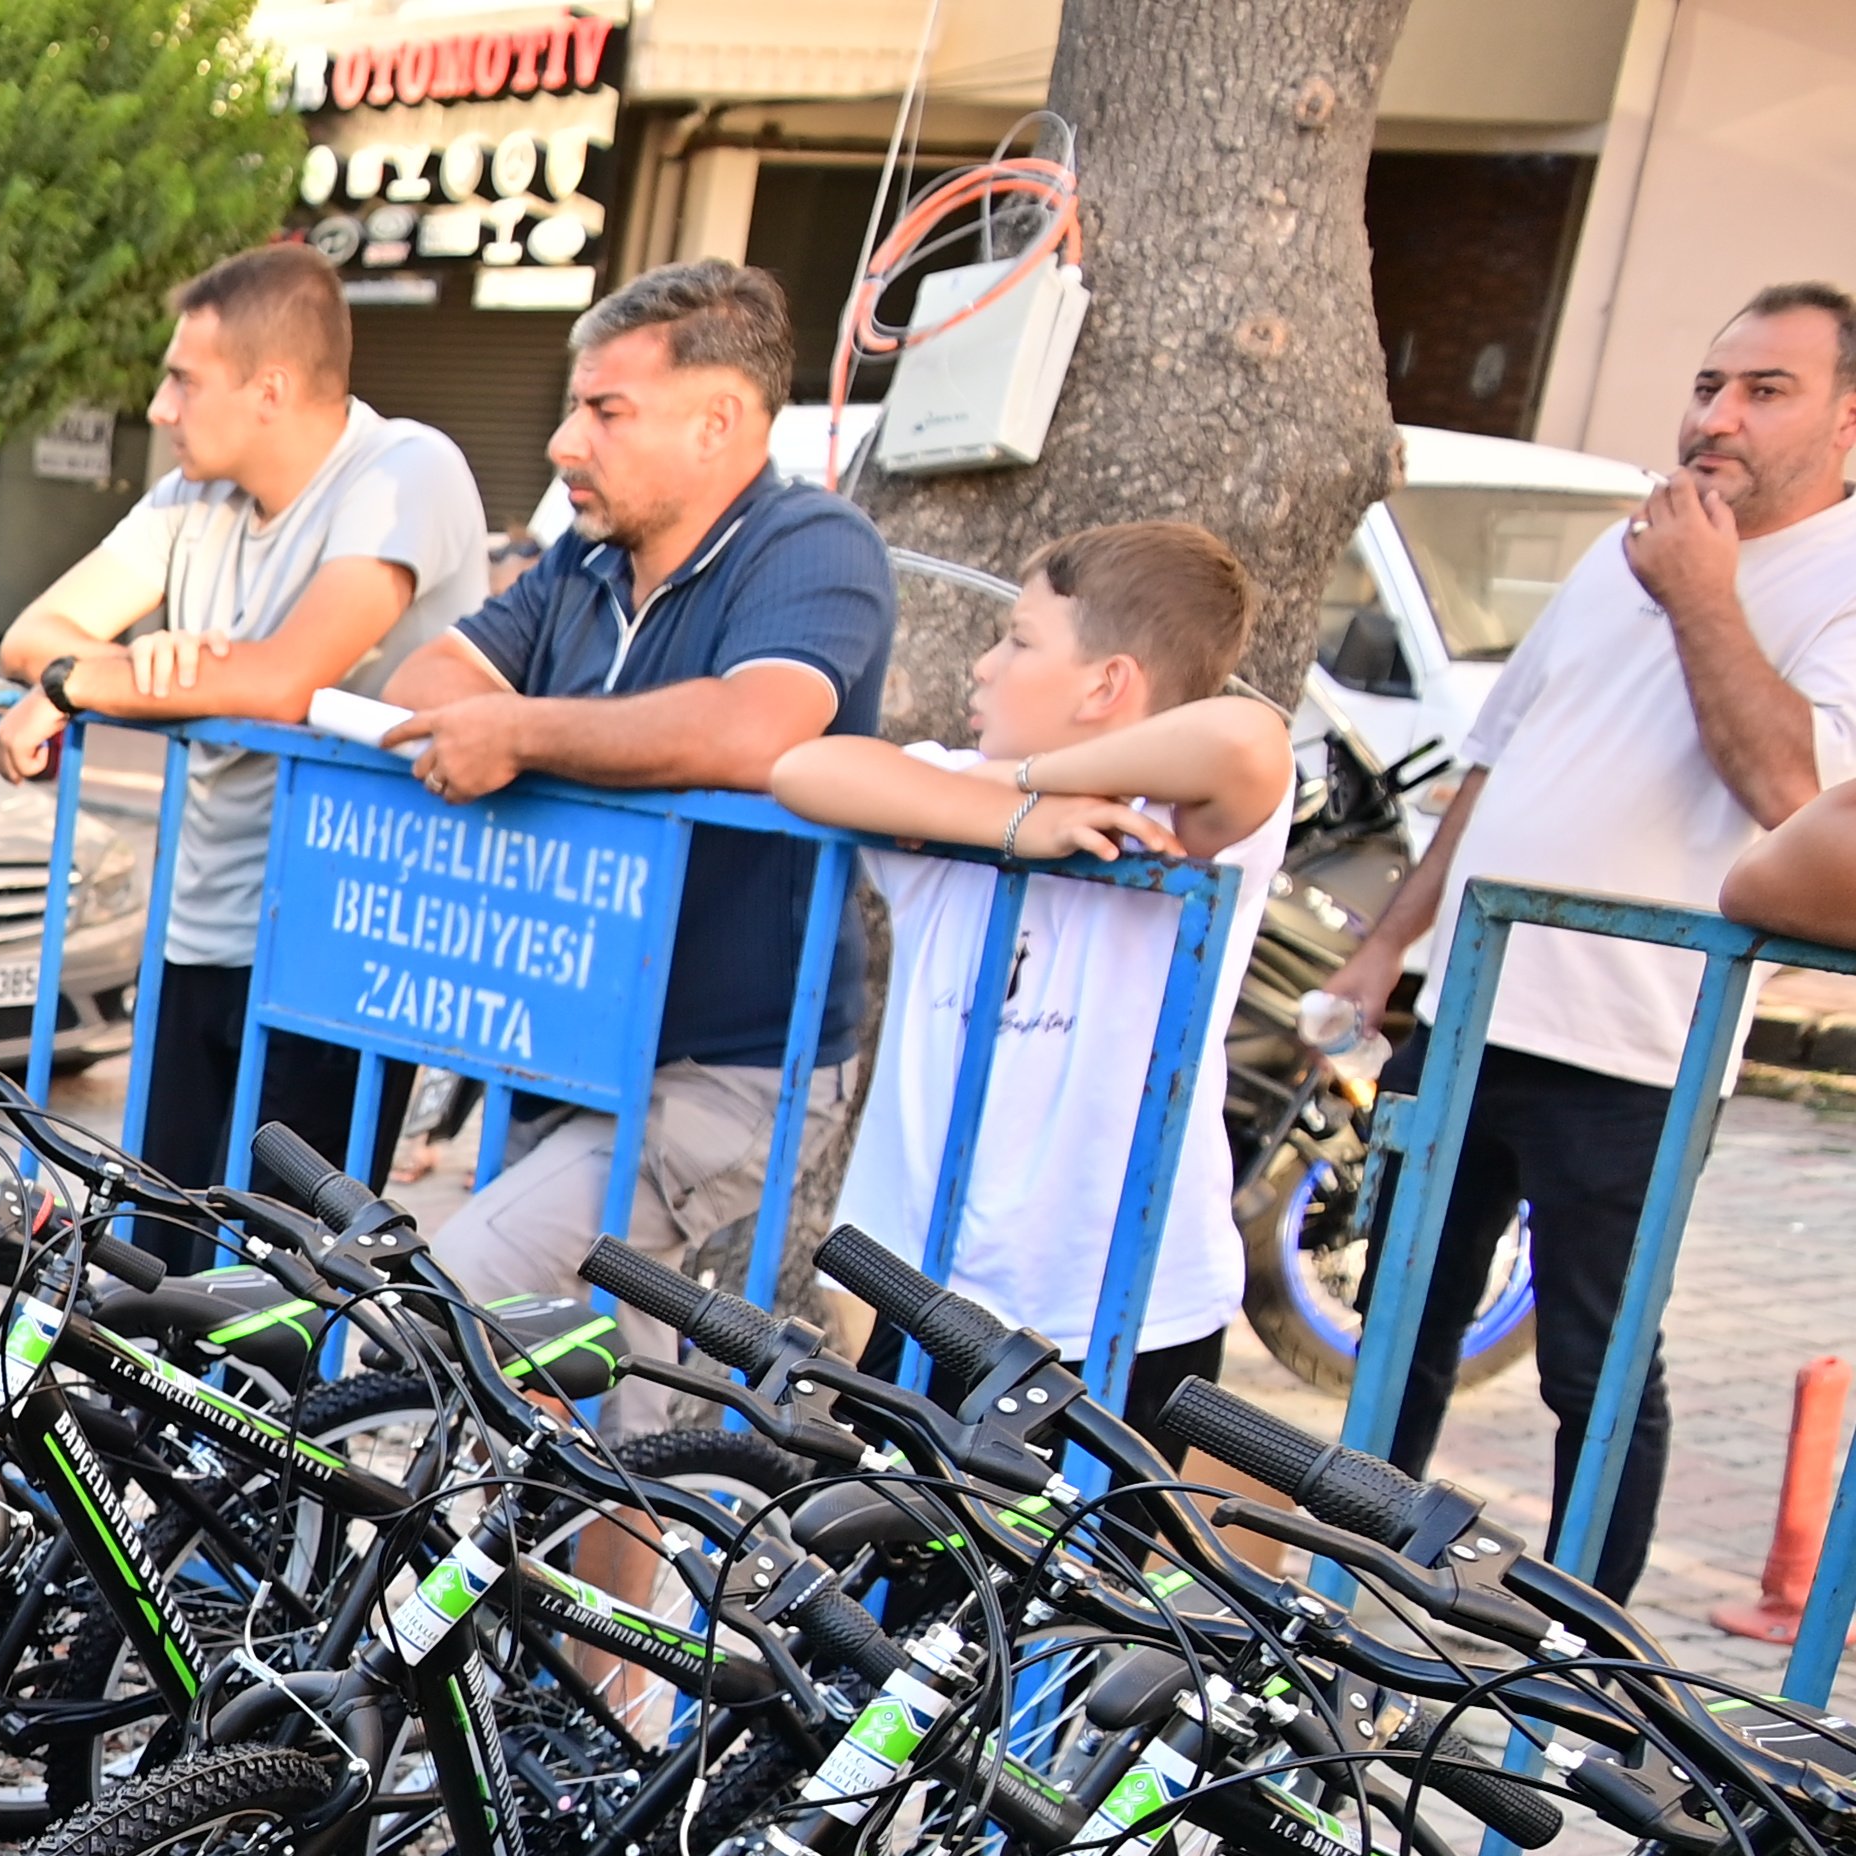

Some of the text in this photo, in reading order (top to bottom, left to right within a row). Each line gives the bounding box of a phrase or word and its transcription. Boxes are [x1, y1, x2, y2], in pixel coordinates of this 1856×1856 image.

[332, 6, 614, 111] OTOMOTİV
[305, 793, 649, 920] BAHÇELİEVLER
[332, 877, 595, 991] BELEDİYESİ
[355, 960, 533, 1059] ZABITA
[109, 1355, 138, 1382] T.C.
[138, 1366, 239, 1431] BAHÇELİEVLER
[53, 1410, 212, 1685] BAHÇELİEVLER BELEDİYES
[1267, 1812, 1299, 1843] T.C.
